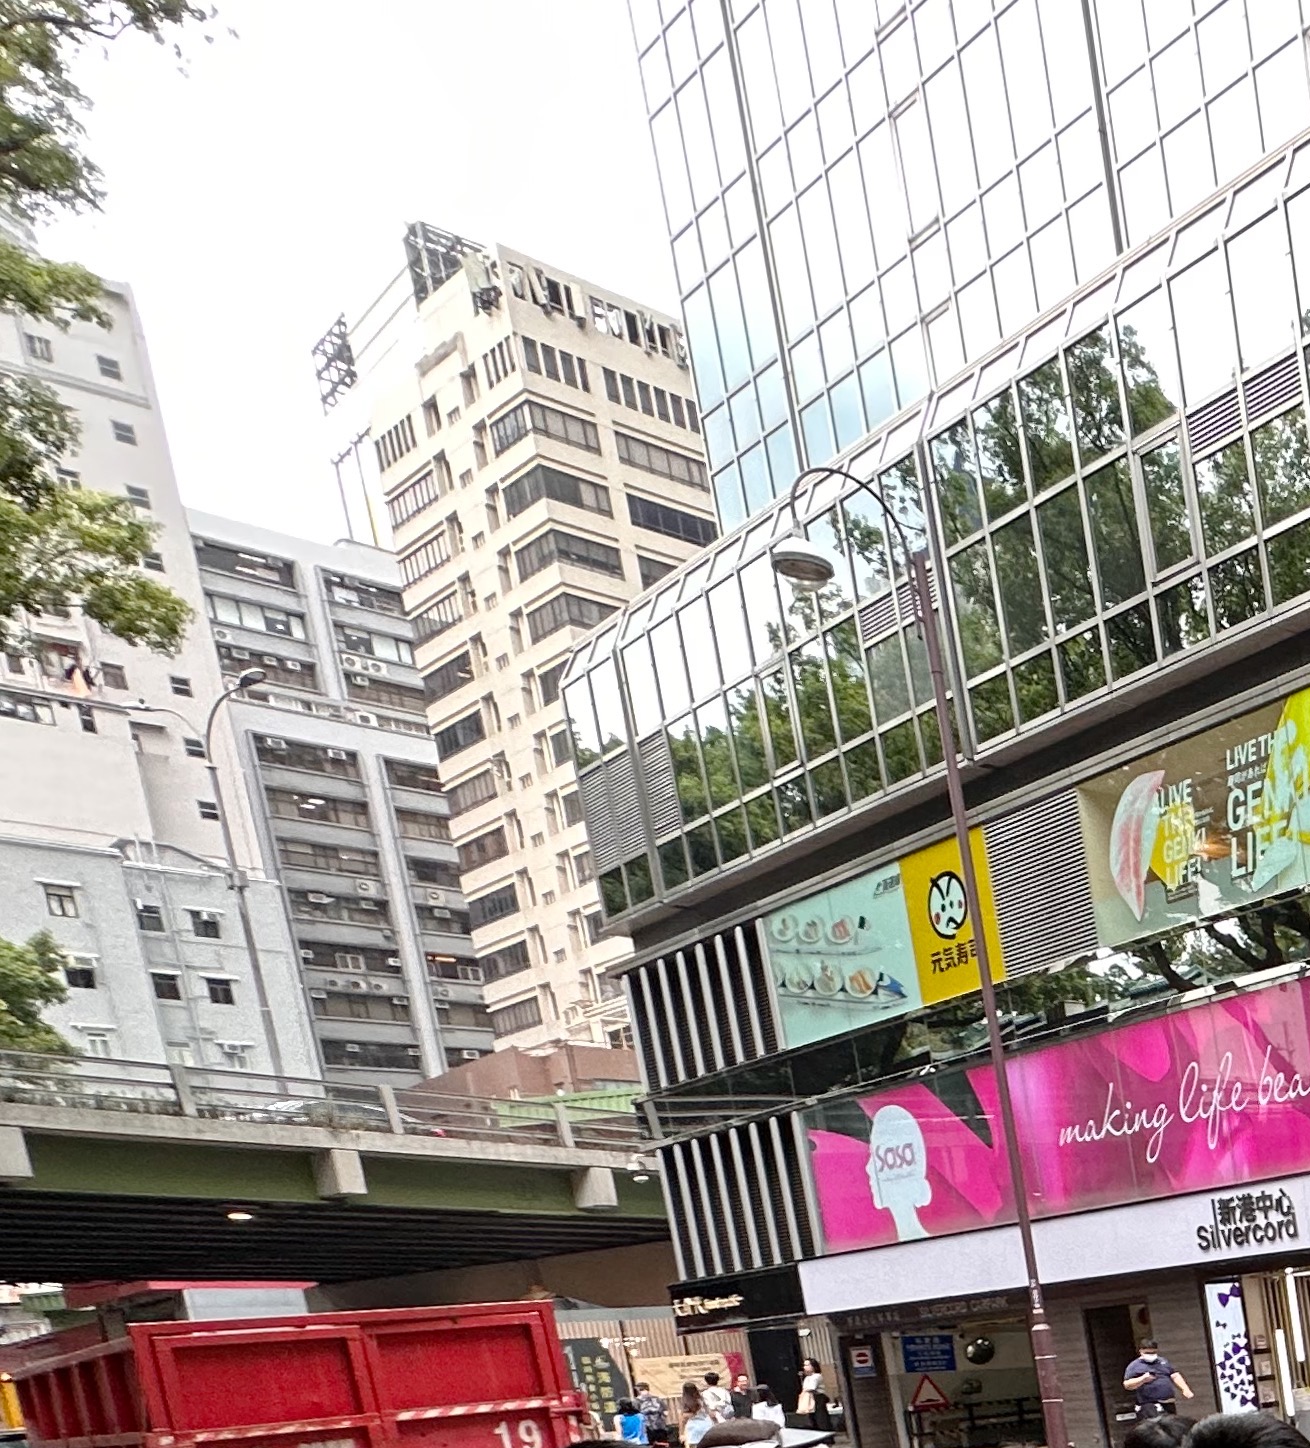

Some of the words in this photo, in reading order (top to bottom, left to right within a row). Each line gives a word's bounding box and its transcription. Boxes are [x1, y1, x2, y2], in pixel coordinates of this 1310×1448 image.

[1226, 738, 1257, 771] LIVE
[1058, 1082, 1175, 1164] making
[1178, 1051, 1251, 1150] life
[1196, 1199, 1300, 1252] Silvercord
[1216, 1187, 1295, 1228] 新港中心
